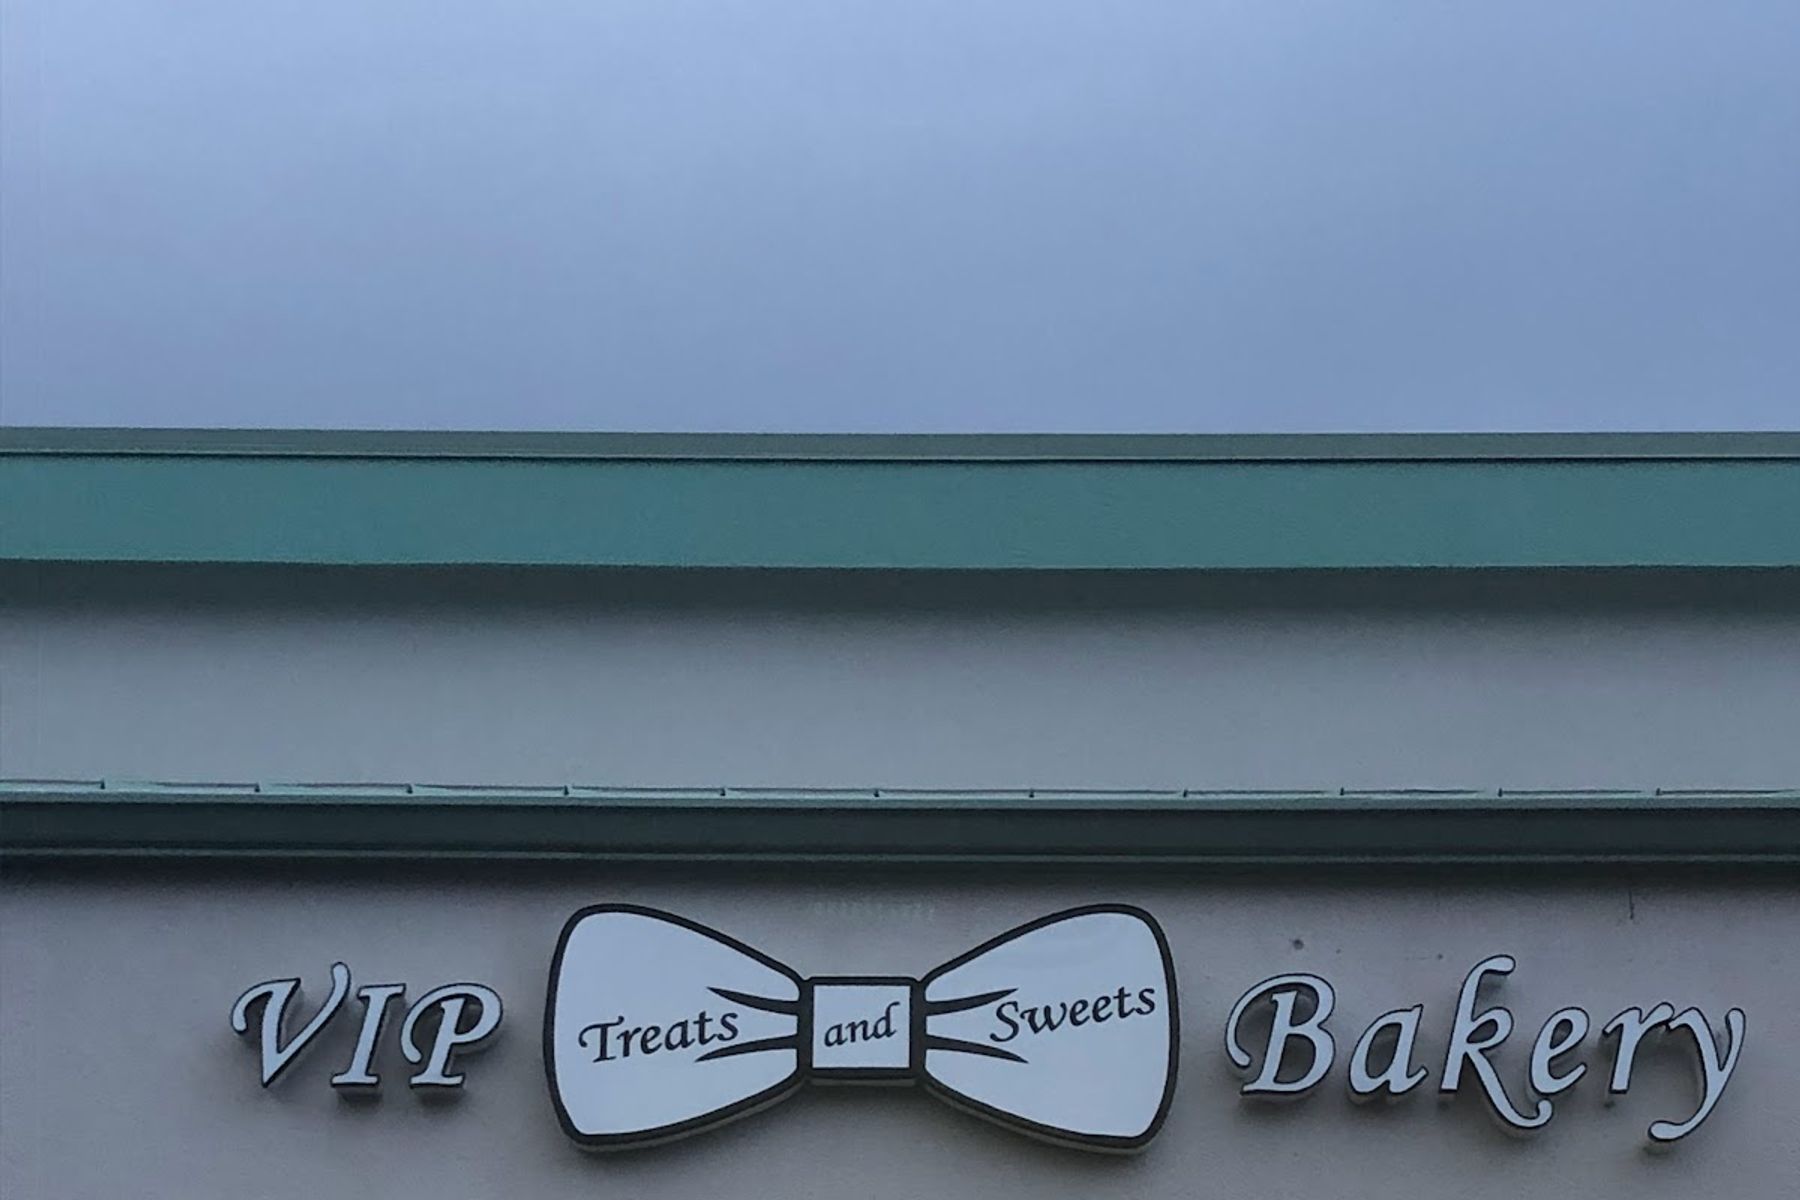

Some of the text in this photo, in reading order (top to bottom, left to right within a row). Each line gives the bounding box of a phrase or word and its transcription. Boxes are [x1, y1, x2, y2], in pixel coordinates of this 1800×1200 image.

[230, 961, 502, 1088] VIP
[578, 986, 1156, 1064] Treats and Sweets
[1225, 954, 1746, 1141] Bakery
